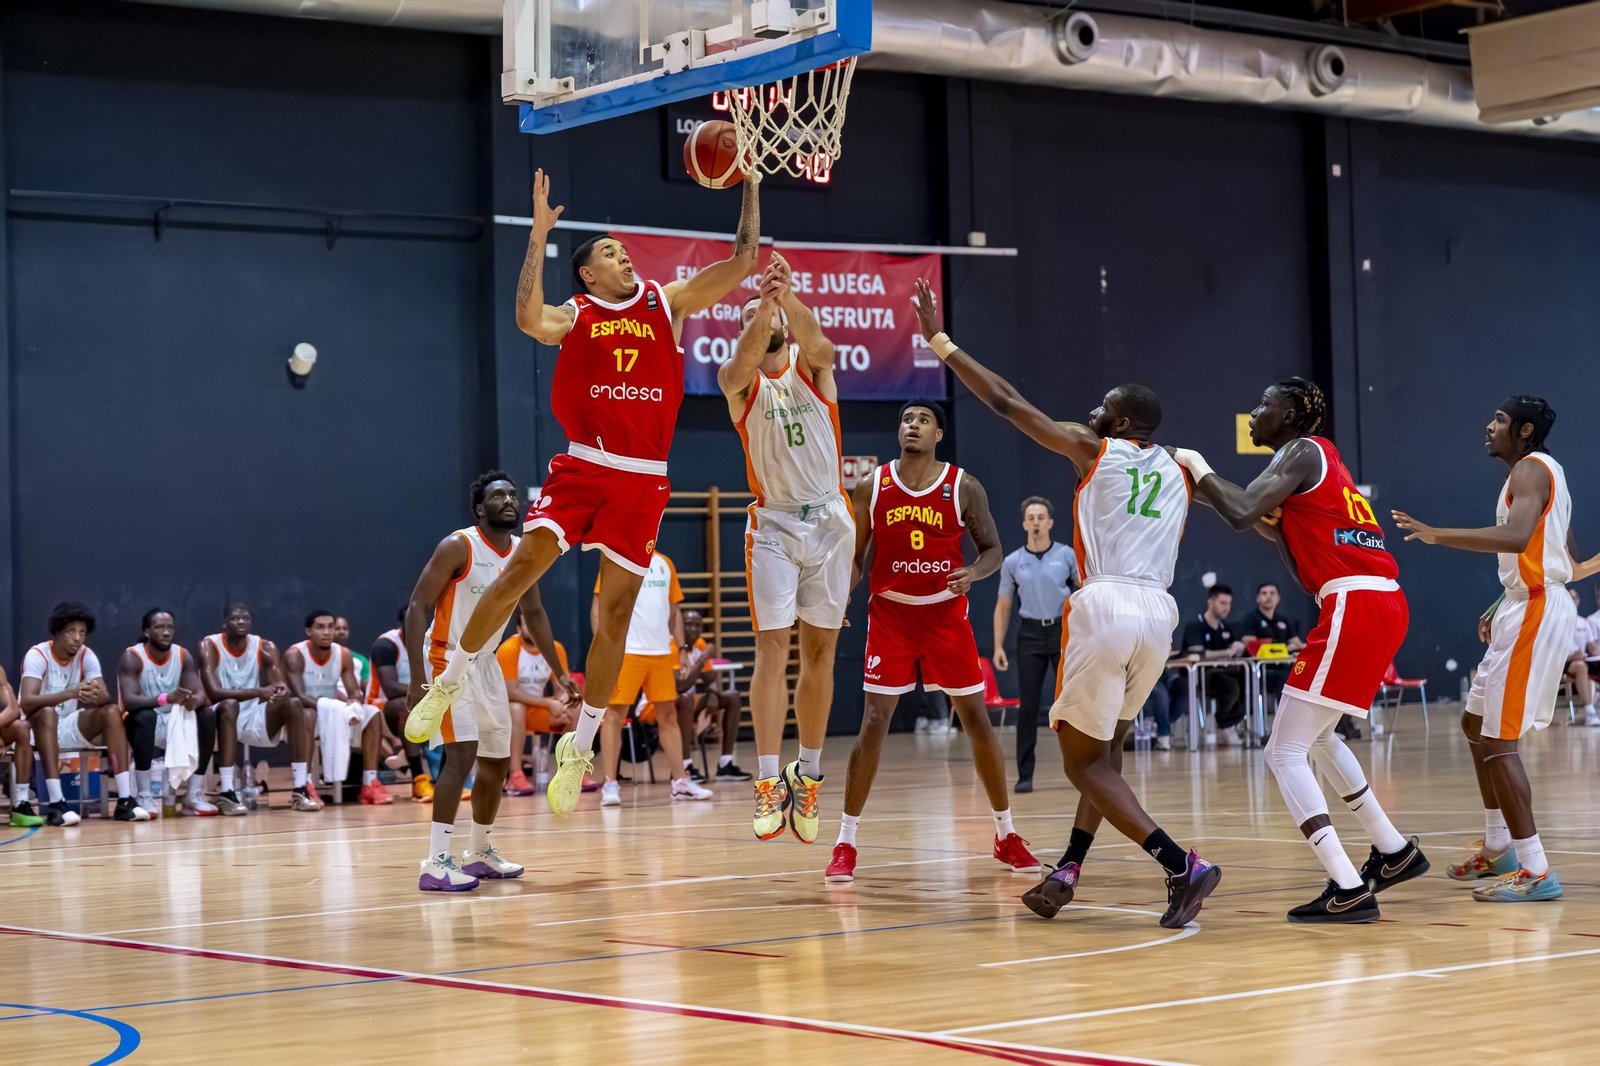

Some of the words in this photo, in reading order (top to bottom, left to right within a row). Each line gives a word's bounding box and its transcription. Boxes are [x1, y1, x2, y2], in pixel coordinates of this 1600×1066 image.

[789, 272, 813, 293] SE
[817, 272, 886, 295] JUEGA
[591, 318, 656, 341] ESPAÑA
[613, 348, 639, 372] 17
[590, 382, 662, 401] endesa
[784, 422, 805, 447] 13
[1126, 468, 1161, 518] 12
[886, 505, 943, 529] ESPAÑA
[910, 530, 924, 550] 8
[892, 559, 951, 574] endesa
